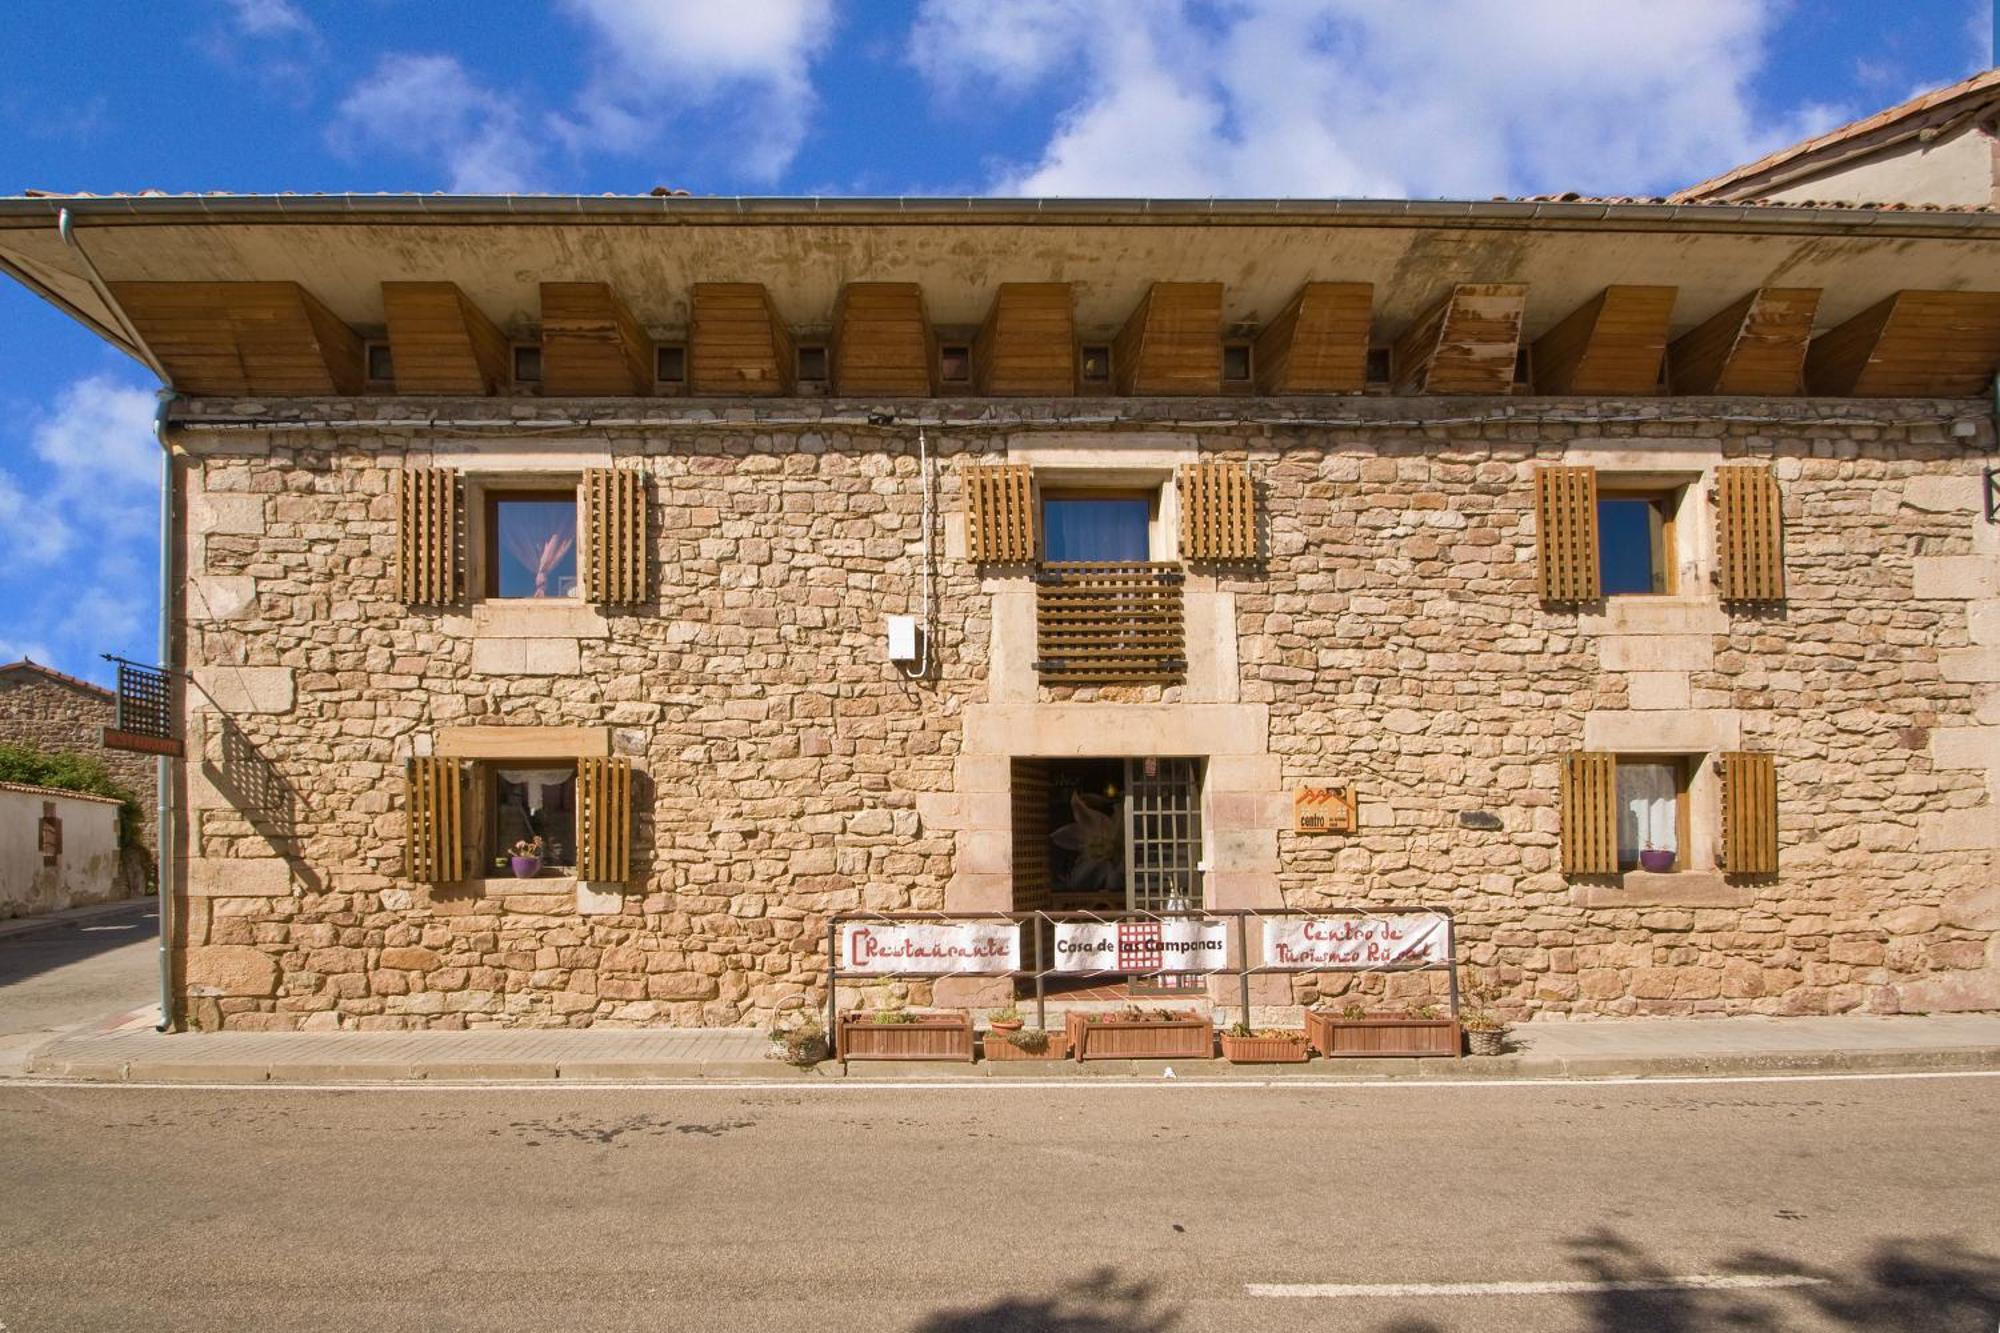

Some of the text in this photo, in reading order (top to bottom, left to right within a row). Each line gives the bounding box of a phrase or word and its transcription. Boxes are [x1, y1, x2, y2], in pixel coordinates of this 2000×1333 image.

[1303, 921, 1403, 941] Centro de
[865, 937, 1010, 958] Restaurante
[1057, 939, 1222, 954] Casa de las Campanas
[1276, 943, 1360, 963] Turismo
